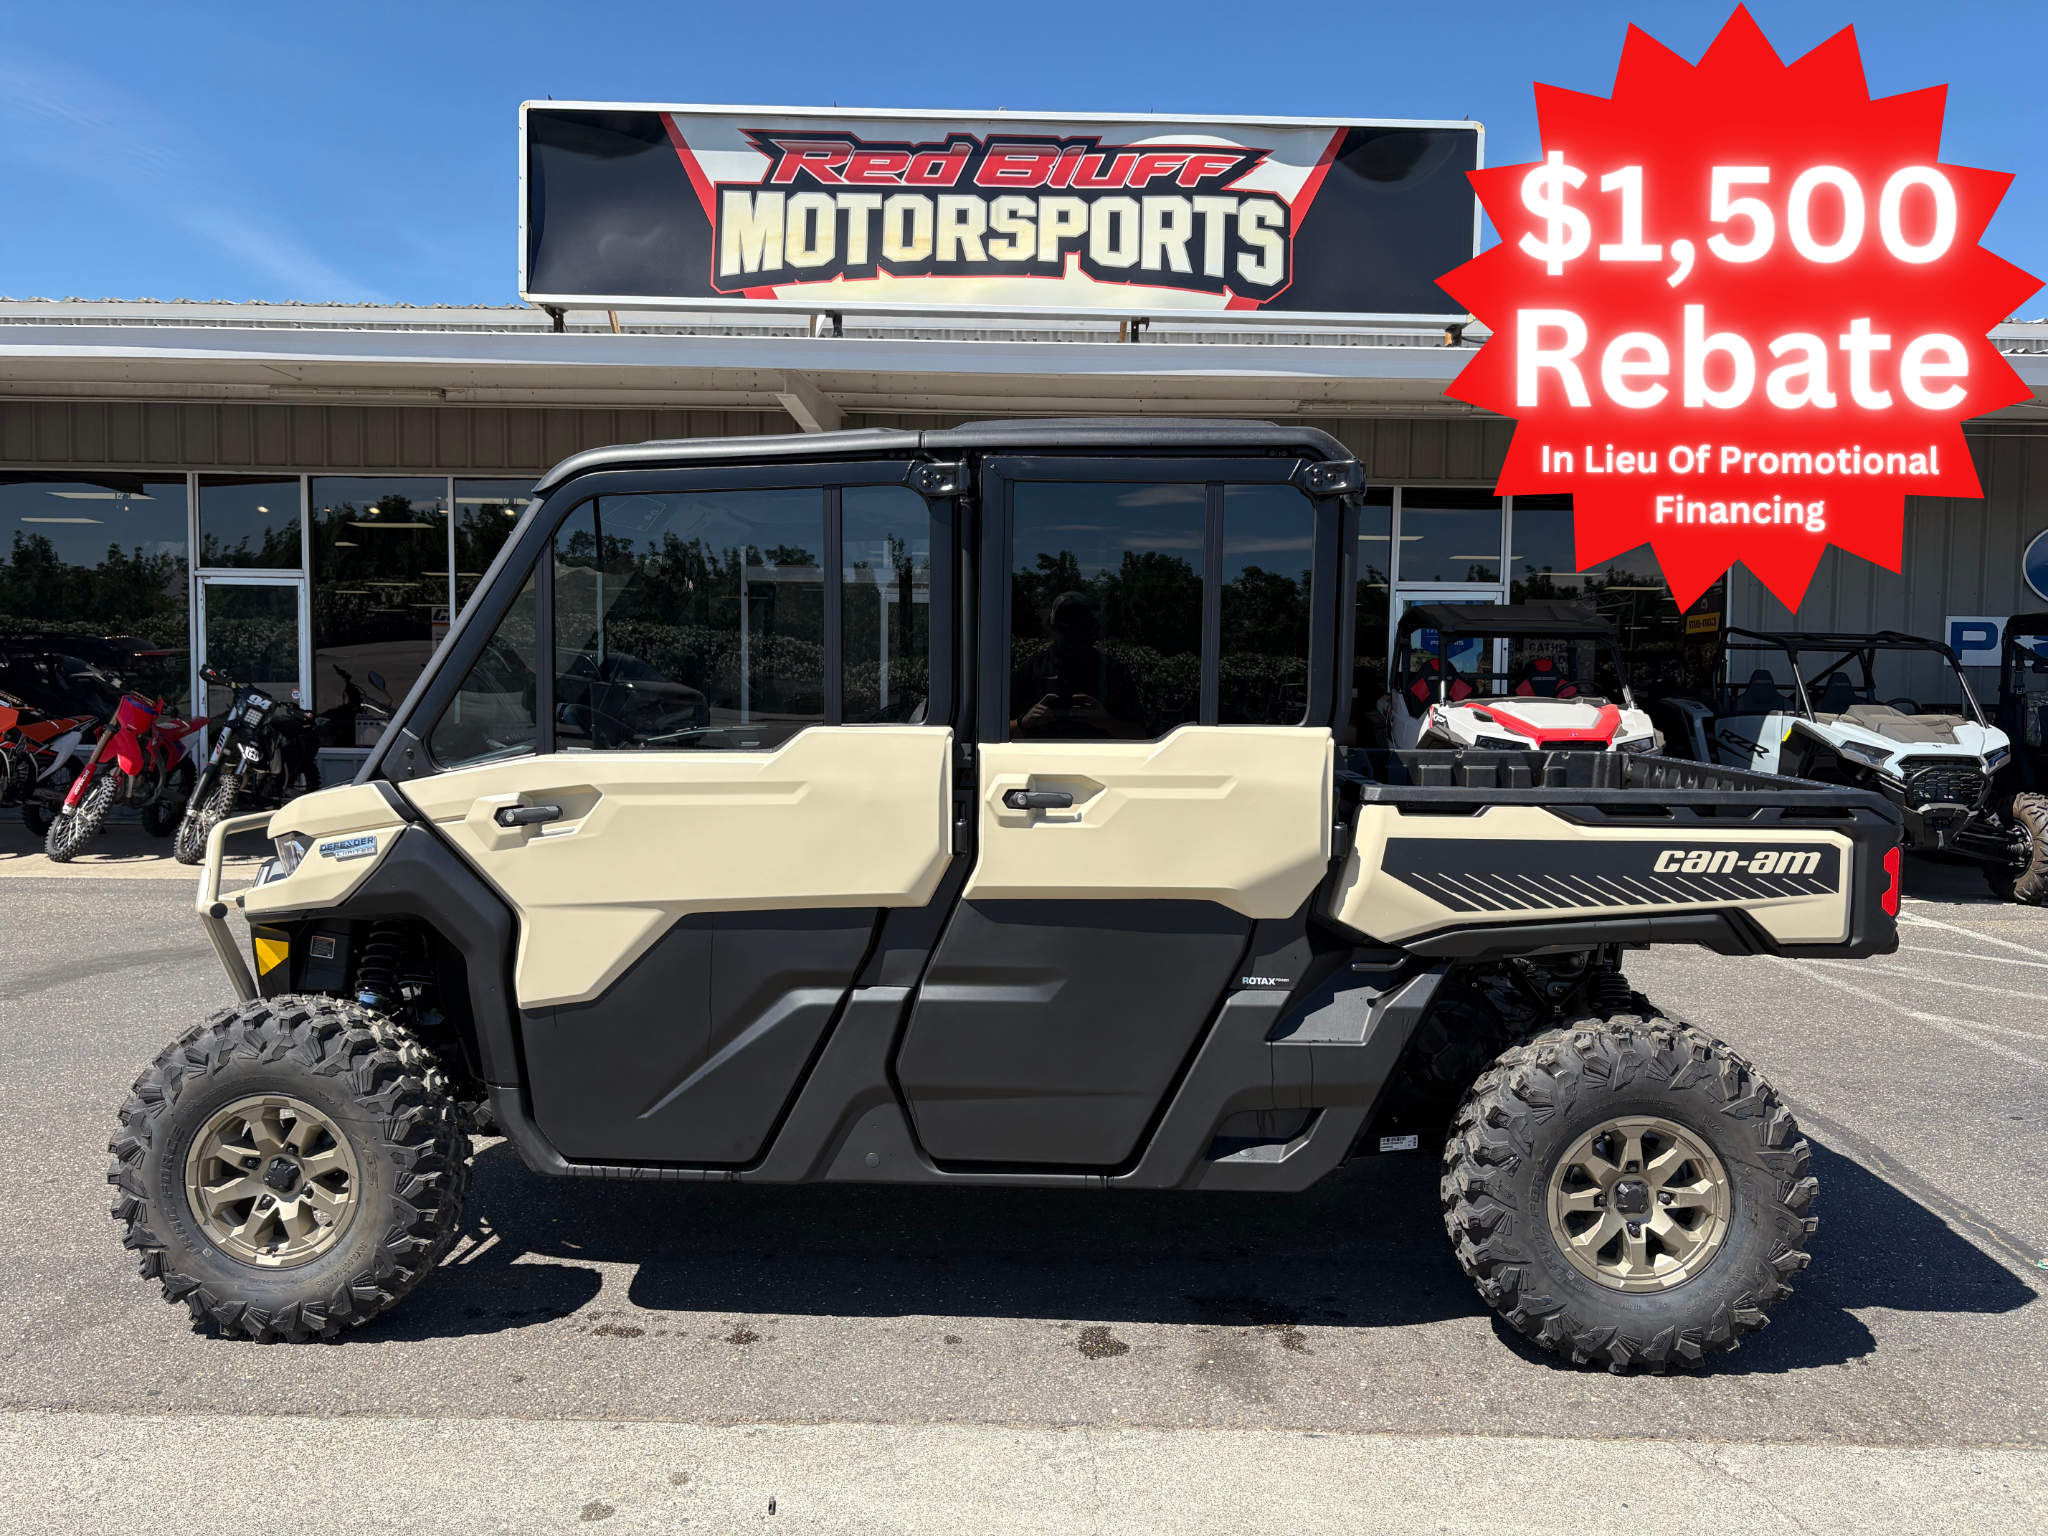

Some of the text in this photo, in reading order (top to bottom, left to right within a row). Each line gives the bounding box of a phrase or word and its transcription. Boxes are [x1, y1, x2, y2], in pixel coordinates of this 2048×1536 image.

[769, 139, 973, 186] Red
[720, 190, 1284, 287] MOTORSPORTS
[1718, 728, 1770, 760] RZR
[74, 769, 90, 796] DUNLOP
[319, 836, 375, 852] DEFENDER
[1653, 850, 1821, 874] can-am
[1242, 976, 1276, 986] ROTAX
[160, 1123, 185, 1199] FORCE
